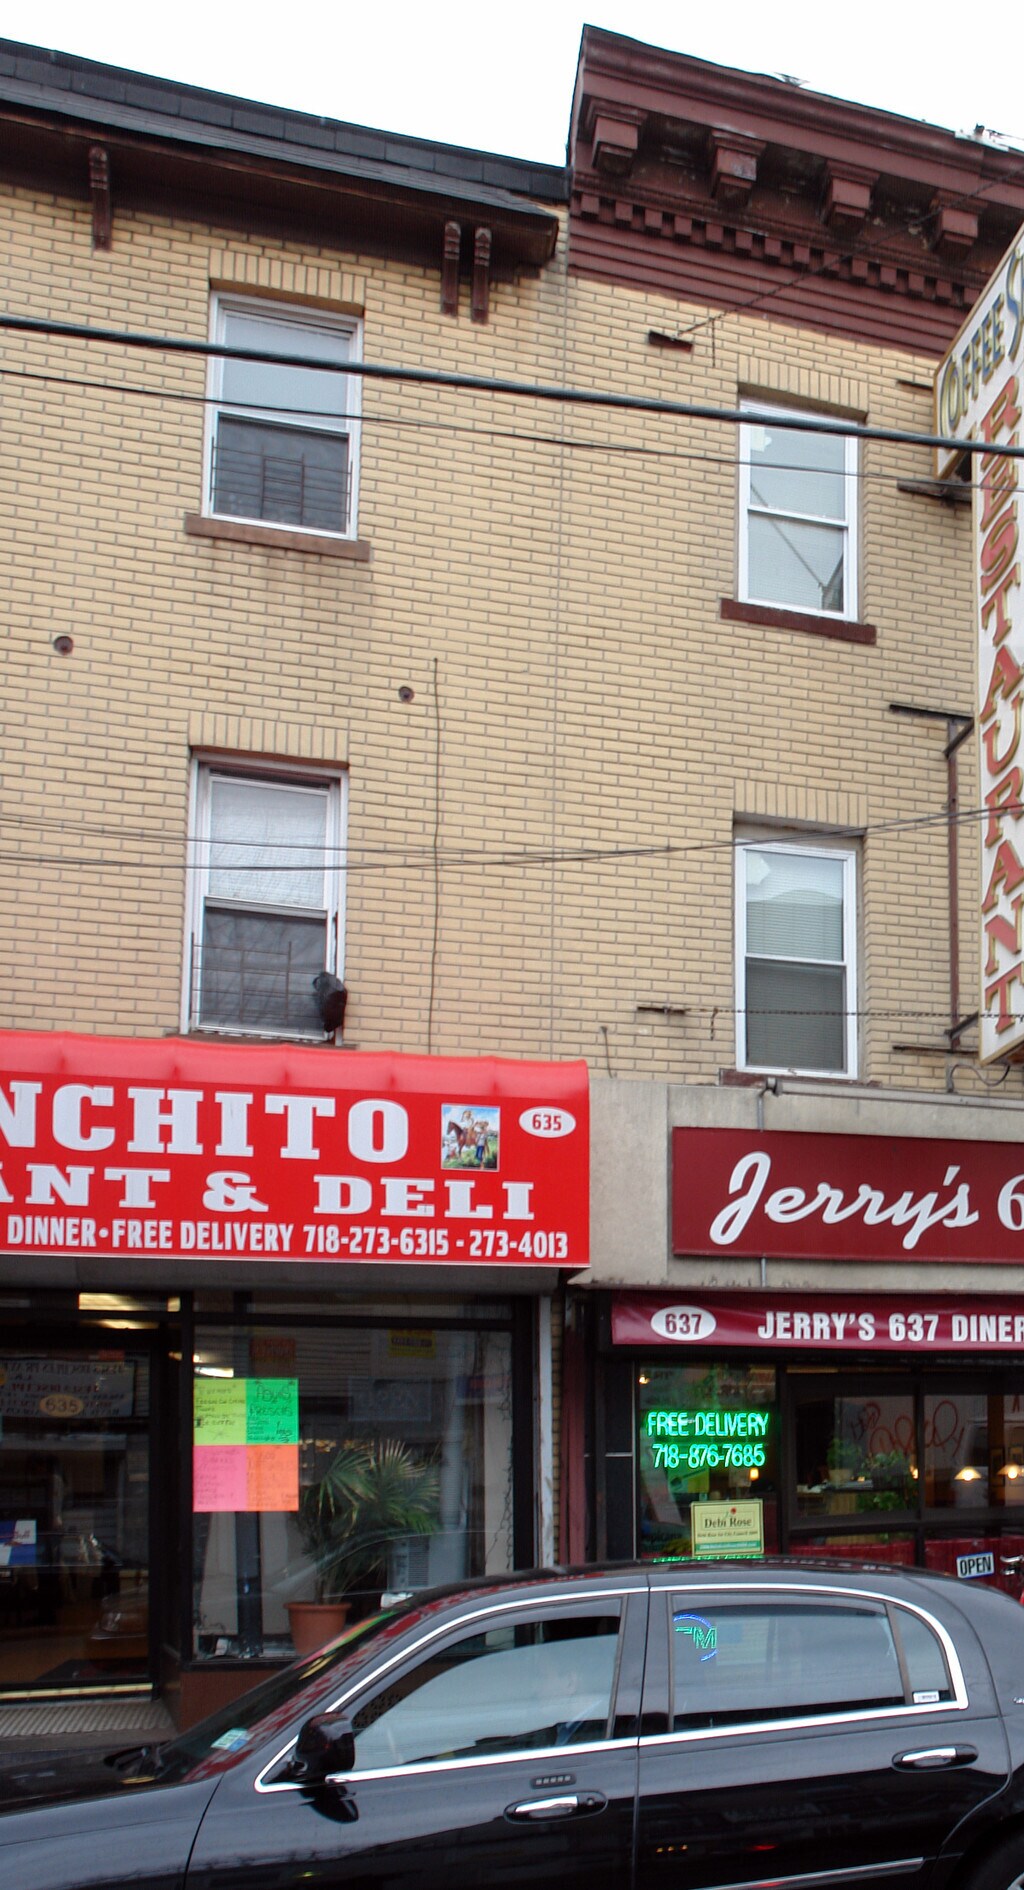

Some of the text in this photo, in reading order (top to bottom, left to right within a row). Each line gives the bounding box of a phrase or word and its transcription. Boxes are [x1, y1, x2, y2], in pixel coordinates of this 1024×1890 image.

[531, 1113, 562, 1132] 635
[0, 1162, 535, 1221] NT & DELI
[710, 1150, 980, 1250] Jerry's
[180, 1221, 295, 1252] DELIVERY
[303, 1224, 449, 1256] 718-273-6315
[469, 1230, 569, 1259] 273-4013
[664, 1313, 702, 1335] 637
[758, 1311, 875, 1341] JERRY'S
[889, 1314, 939, 1342] 637
[647, 1411, 769, 1437] FREE DELIVERY
[652, 1443, 766, 1469] 718-876-7685
[960, 1555, 992, 1577] OPEN
